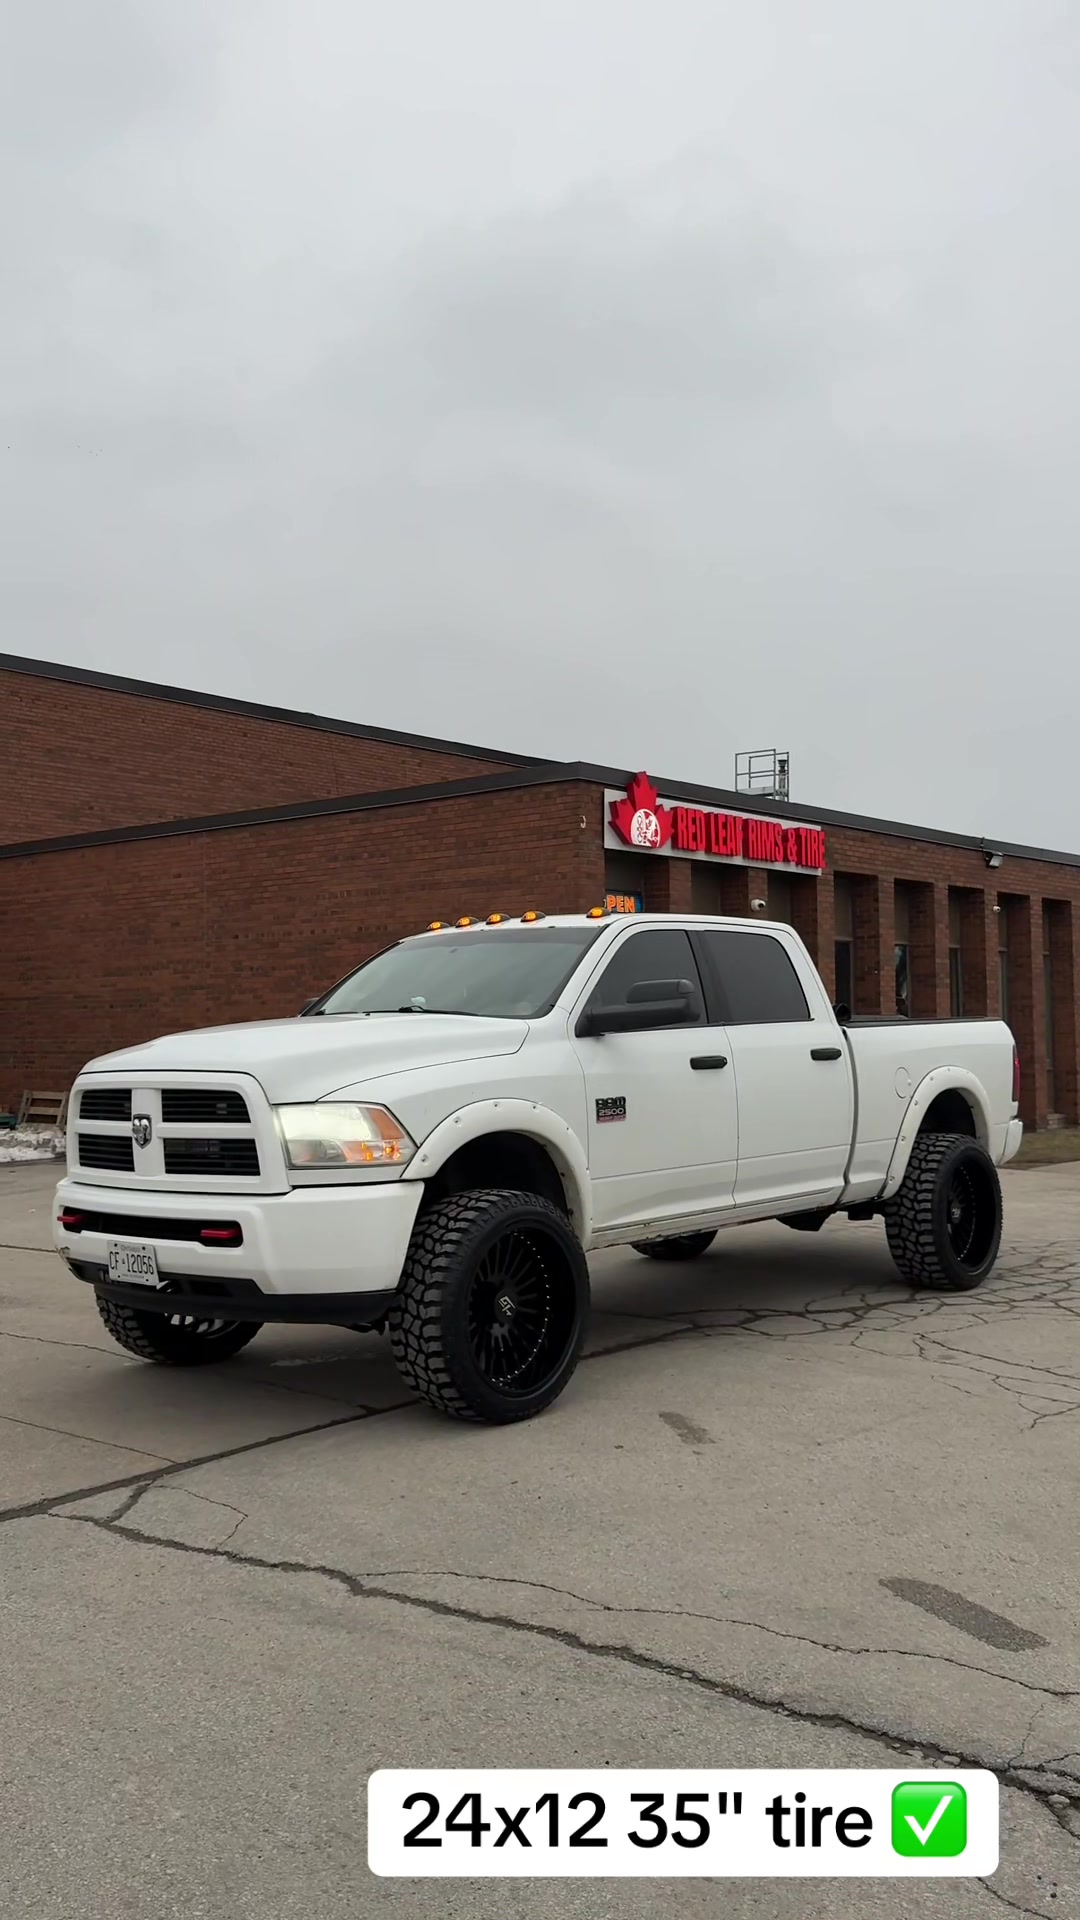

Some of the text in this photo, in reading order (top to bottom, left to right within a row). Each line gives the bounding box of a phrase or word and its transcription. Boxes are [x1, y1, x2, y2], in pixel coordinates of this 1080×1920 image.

[675, 806, 706, 851] RED
[708, 812, 743, 857] LEAF
[747, 818, 784, 863] RIMS
[786, 828, 798, 863] &
[799, 827, 827, 868] TIRE
[603, 895, 635, 913] PEN
[599, 1108, 624, 1116] 2500
[126, 1253, 155, 1275] 12056
